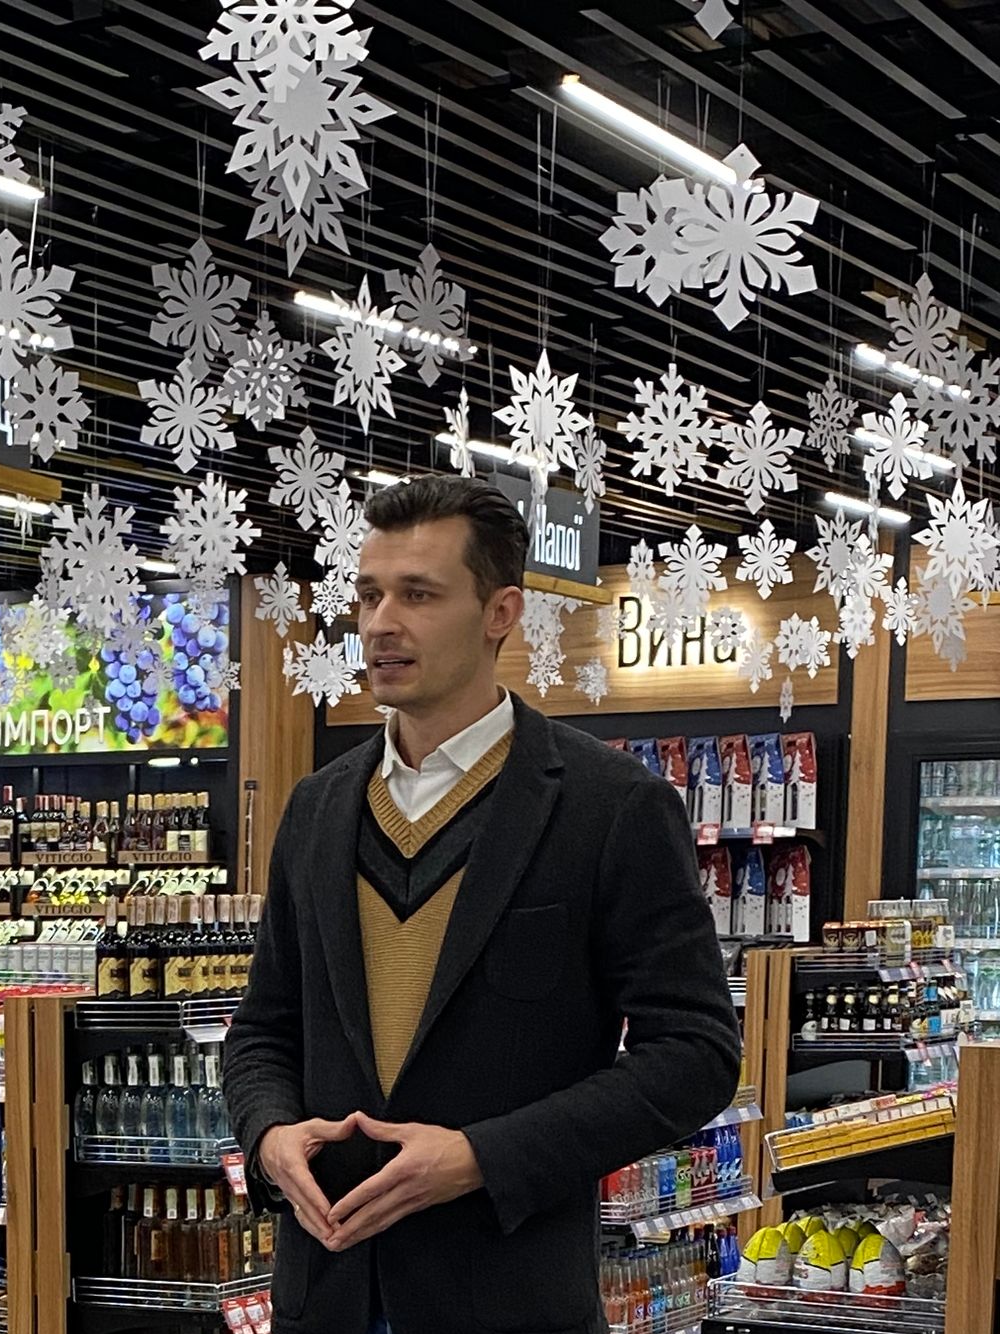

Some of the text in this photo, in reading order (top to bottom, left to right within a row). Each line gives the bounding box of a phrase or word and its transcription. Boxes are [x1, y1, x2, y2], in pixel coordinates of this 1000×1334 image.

[534, 503, 584, 572] Напої
[35, 853, 93, 864] VITICCIO
[132, 852, 193, 863] VITICCIO
[35, 904, 93, 915] VITICCIO
